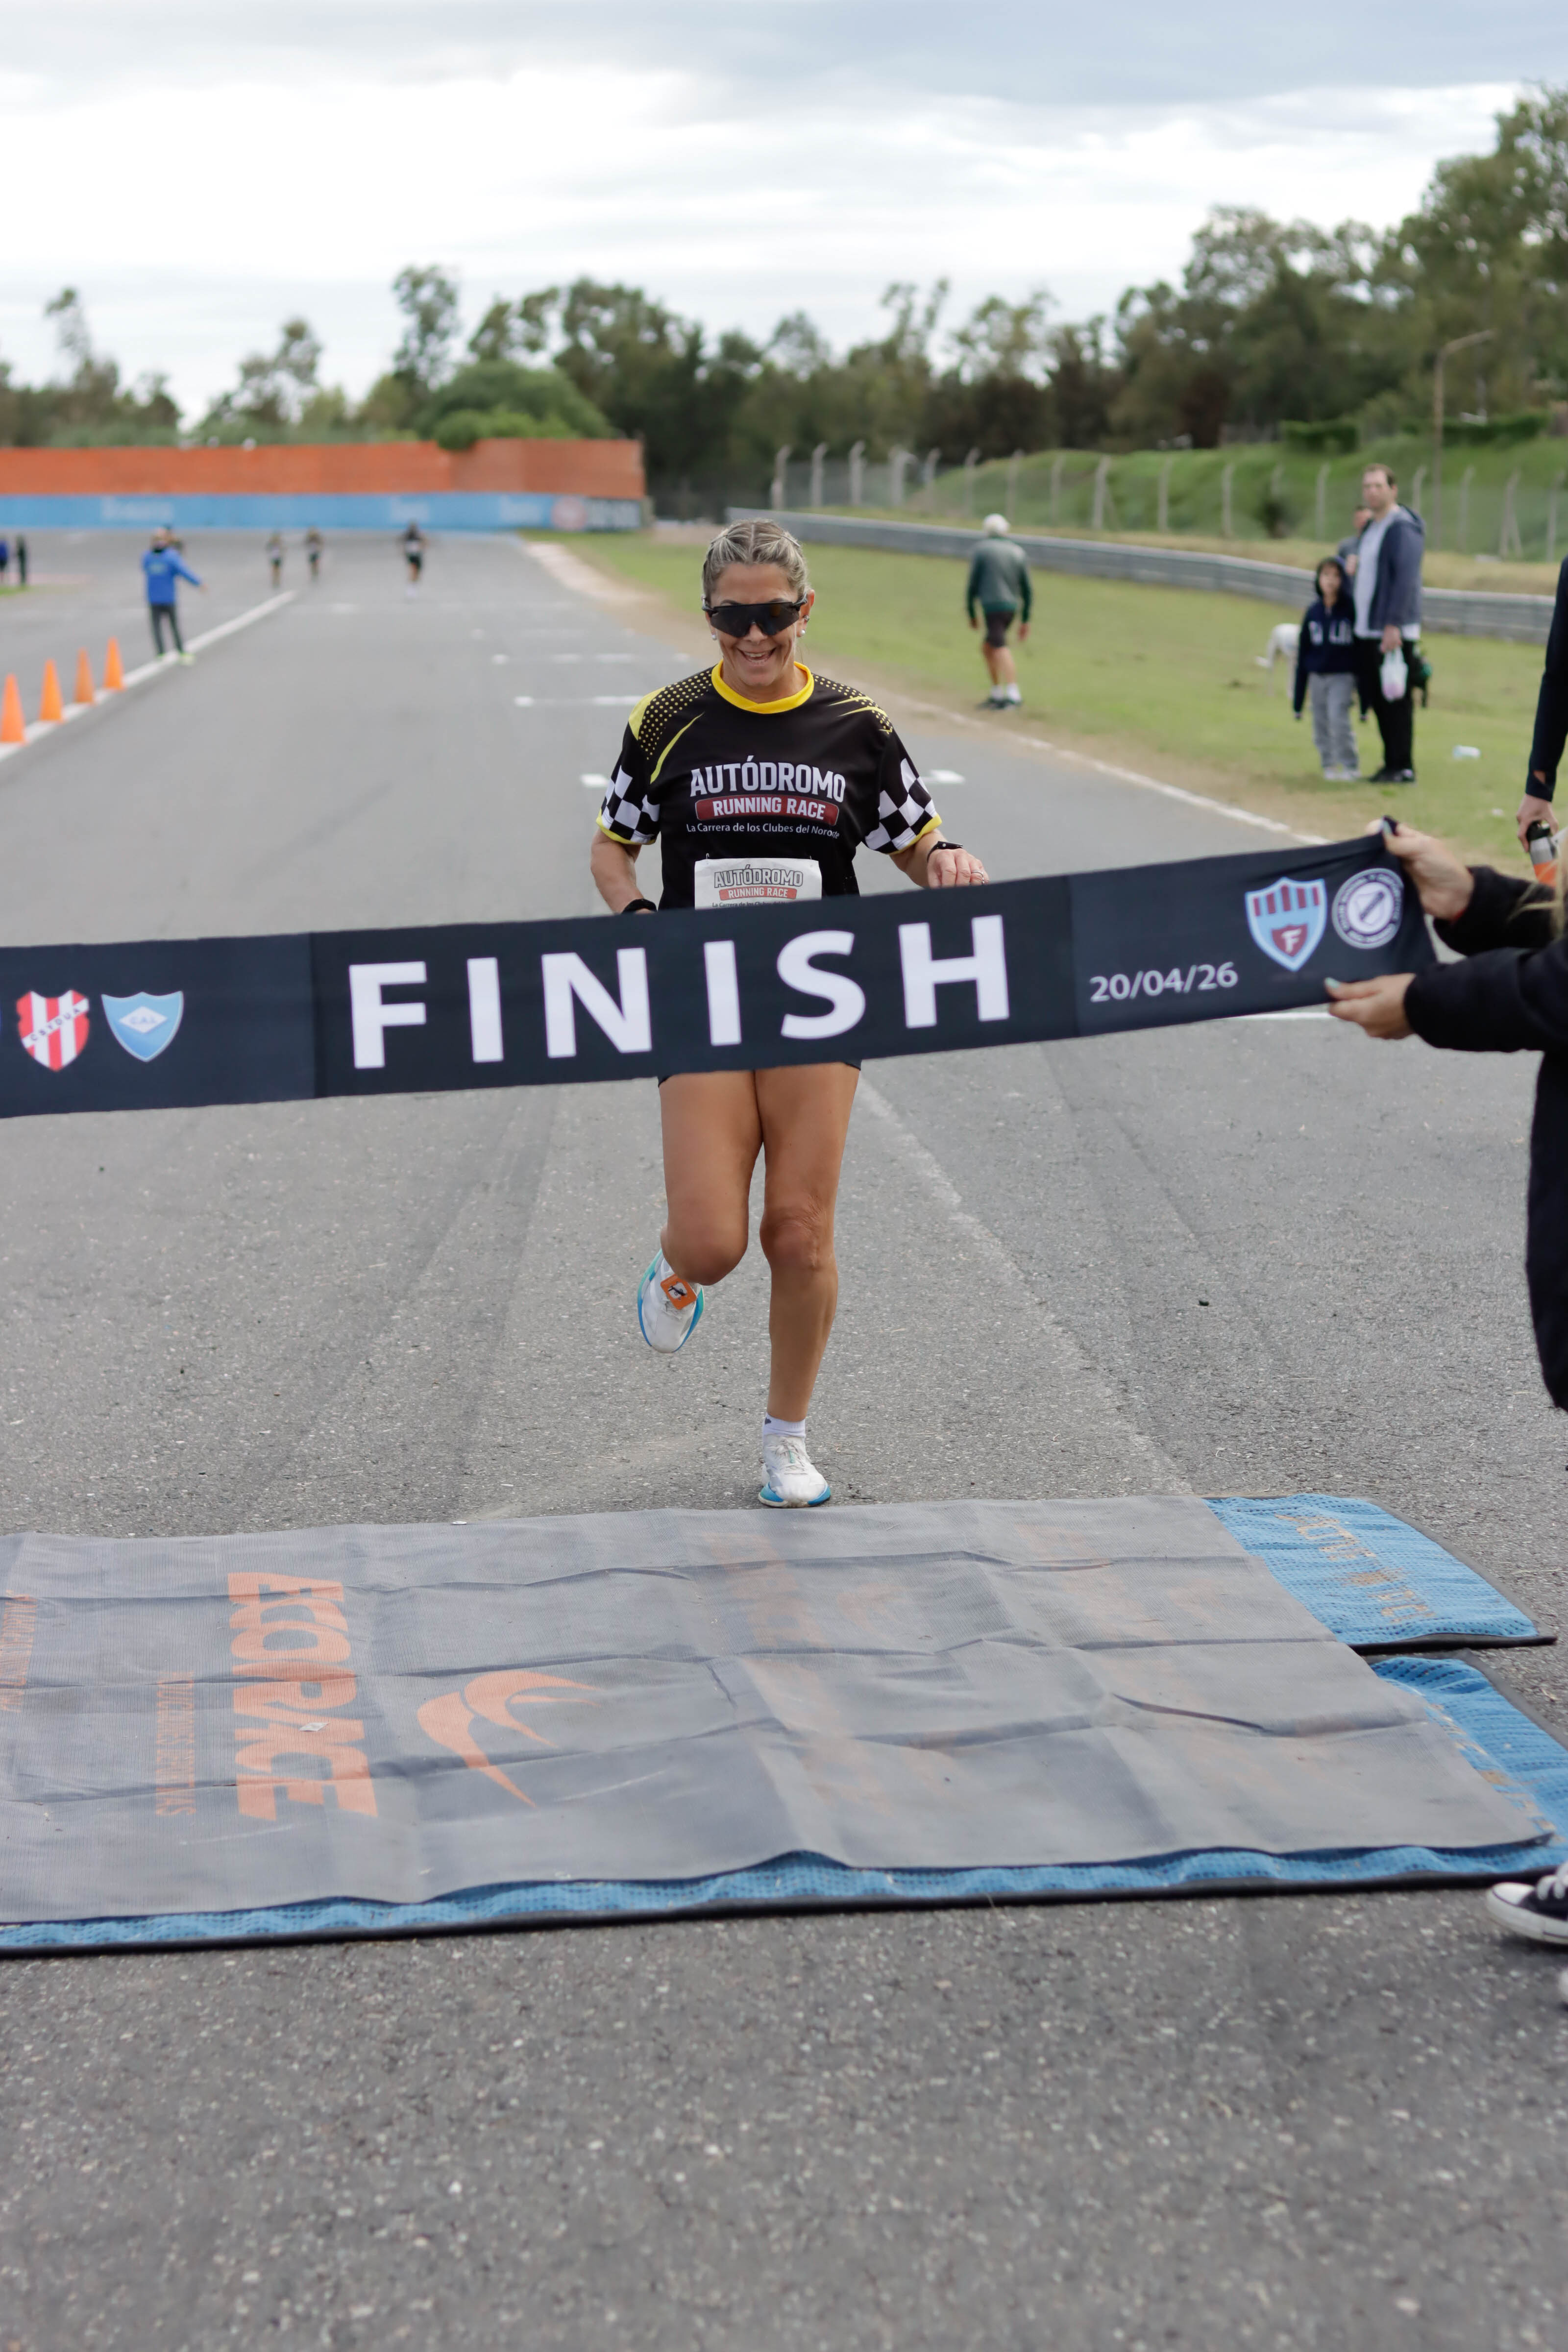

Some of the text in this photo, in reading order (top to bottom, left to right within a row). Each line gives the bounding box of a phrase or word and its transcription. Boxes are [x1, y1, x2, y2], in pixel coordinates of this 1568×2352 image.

[690, 755, 846, 803] AUTÓDROMO
[713, 797, 826, 820] RUNNING RACE
[686, 824, 696, 833] La
[698, 823, 730, 832] Carrera
[733, 823, 744, 832] de
[747, 823, 760, 832] los
[763, 823, 793, 833] Clubes
[796, 824, 809, 833] del
[714, 864, 804, 888] AUTÓDROMO
[728, 887, 788, 898] RUNNING RACE
[349, 914, 1010, 1068] FINISH
[1090, 961, 1238, 1002] 20/04/26
